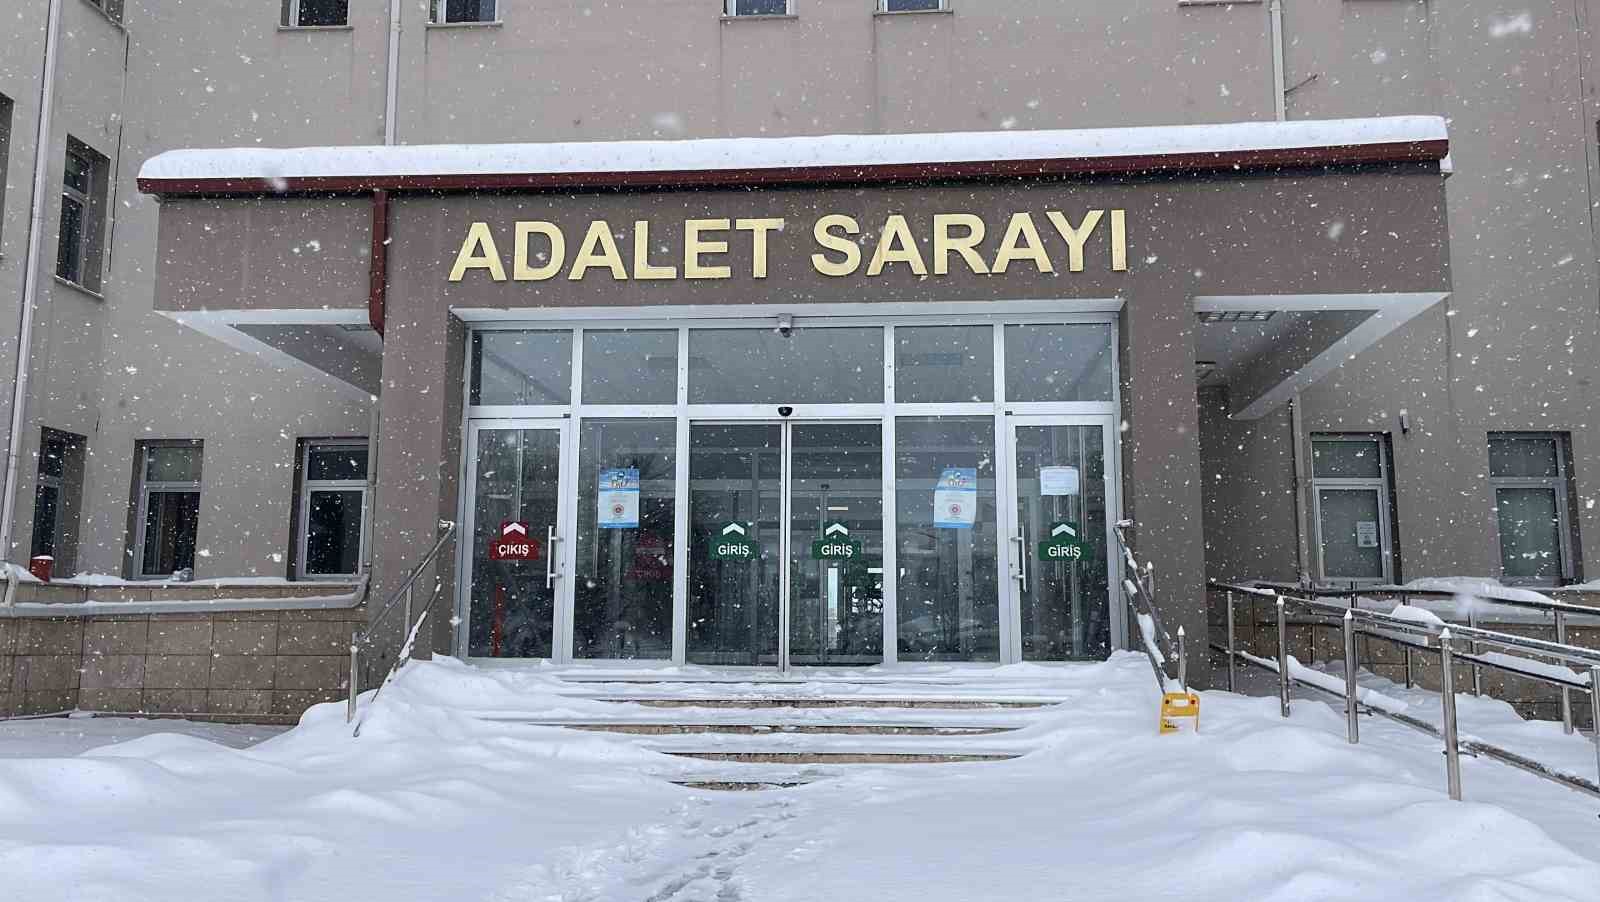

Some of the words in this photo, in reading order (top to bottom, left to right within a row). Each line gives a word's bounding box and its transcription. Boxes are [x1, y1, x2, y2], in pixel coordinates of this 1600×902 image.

[448, 217, 785, 281] ADALET
[811, 210, 1128, 276] SARAYI
[498, 544, 529, 557] ÇIKIŞ
[718, 543, 750, 558] GİRİŞ
[821, 543, 853, 558] GİRİŞ
[1048, 544, 1081, 560] GİRİŞ
